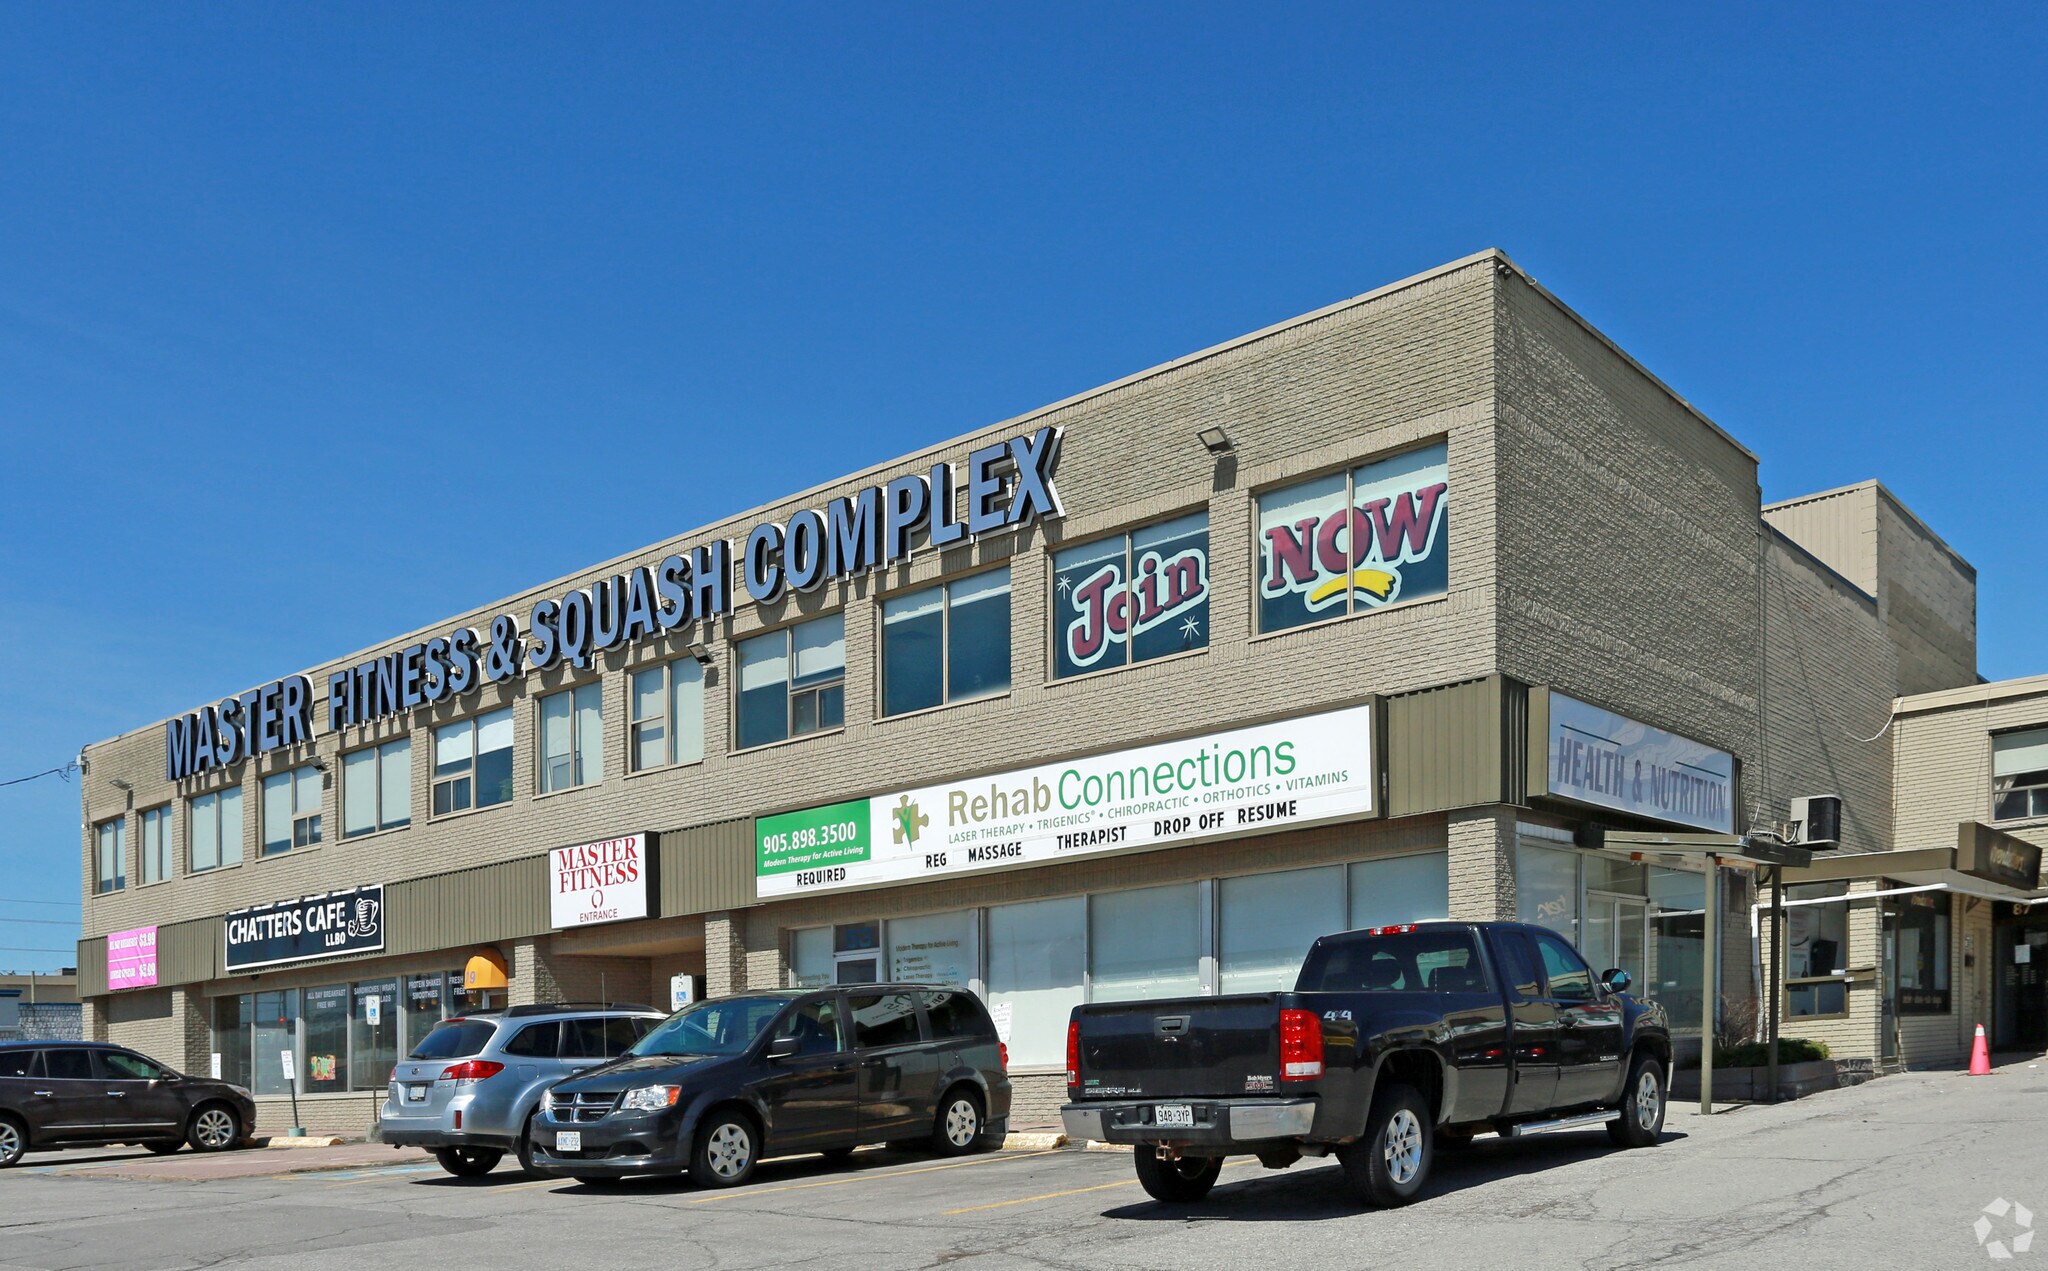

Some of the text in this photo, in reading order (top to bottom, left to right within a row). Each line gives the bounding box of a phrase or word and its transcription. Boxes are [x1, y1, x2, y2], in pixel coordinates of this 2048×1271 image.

[1071, 481, 1448, 661] Join NOW
[166, 426, 1063, 781] MASTER FITNESS & SQUASH COMPLEX
[948, 740, 1297, 827] Rehab Connections
[1557, 736, 1727, 823] HEALTH & NUTRITION
[949, 831, 977, 844] LASER
[981, 823, 1025, 839] THERAPY
[1107, 795, 1190, 820] CHIROPRACTIC
[1203, 783, 1271, 804] ORTHOTICS
[1285, 770, 1349, 791] VITAMINS
[558, 837, 638, 872] MASTER
[763, 821, 857, 855] 905.898.3500
[796, 800, 1297, 886] REQUIRED REG MASSAGE THERAPIST DROP OFF RESUME
[763, 846, 864, 868] Modern Therapy for Active Living
[559, 859, 638, 893] FITNESS
[228, 901, 346, 945] CHATTERS CAFE
[579, 908, 618, 922] ENTRANCE
[307, 989, 346, 1000] ALL DAY BREAKFAST
[353, 983, 396, 995] SANDWICHES WRAPS
[408, 978, 442, 989] PROTEIN SHAKES
[412, 989, 438, 1000] SMOOTHIES
[448, 976, 464, 985] FRESH
[316, 1001, 327, 1009] FREE
